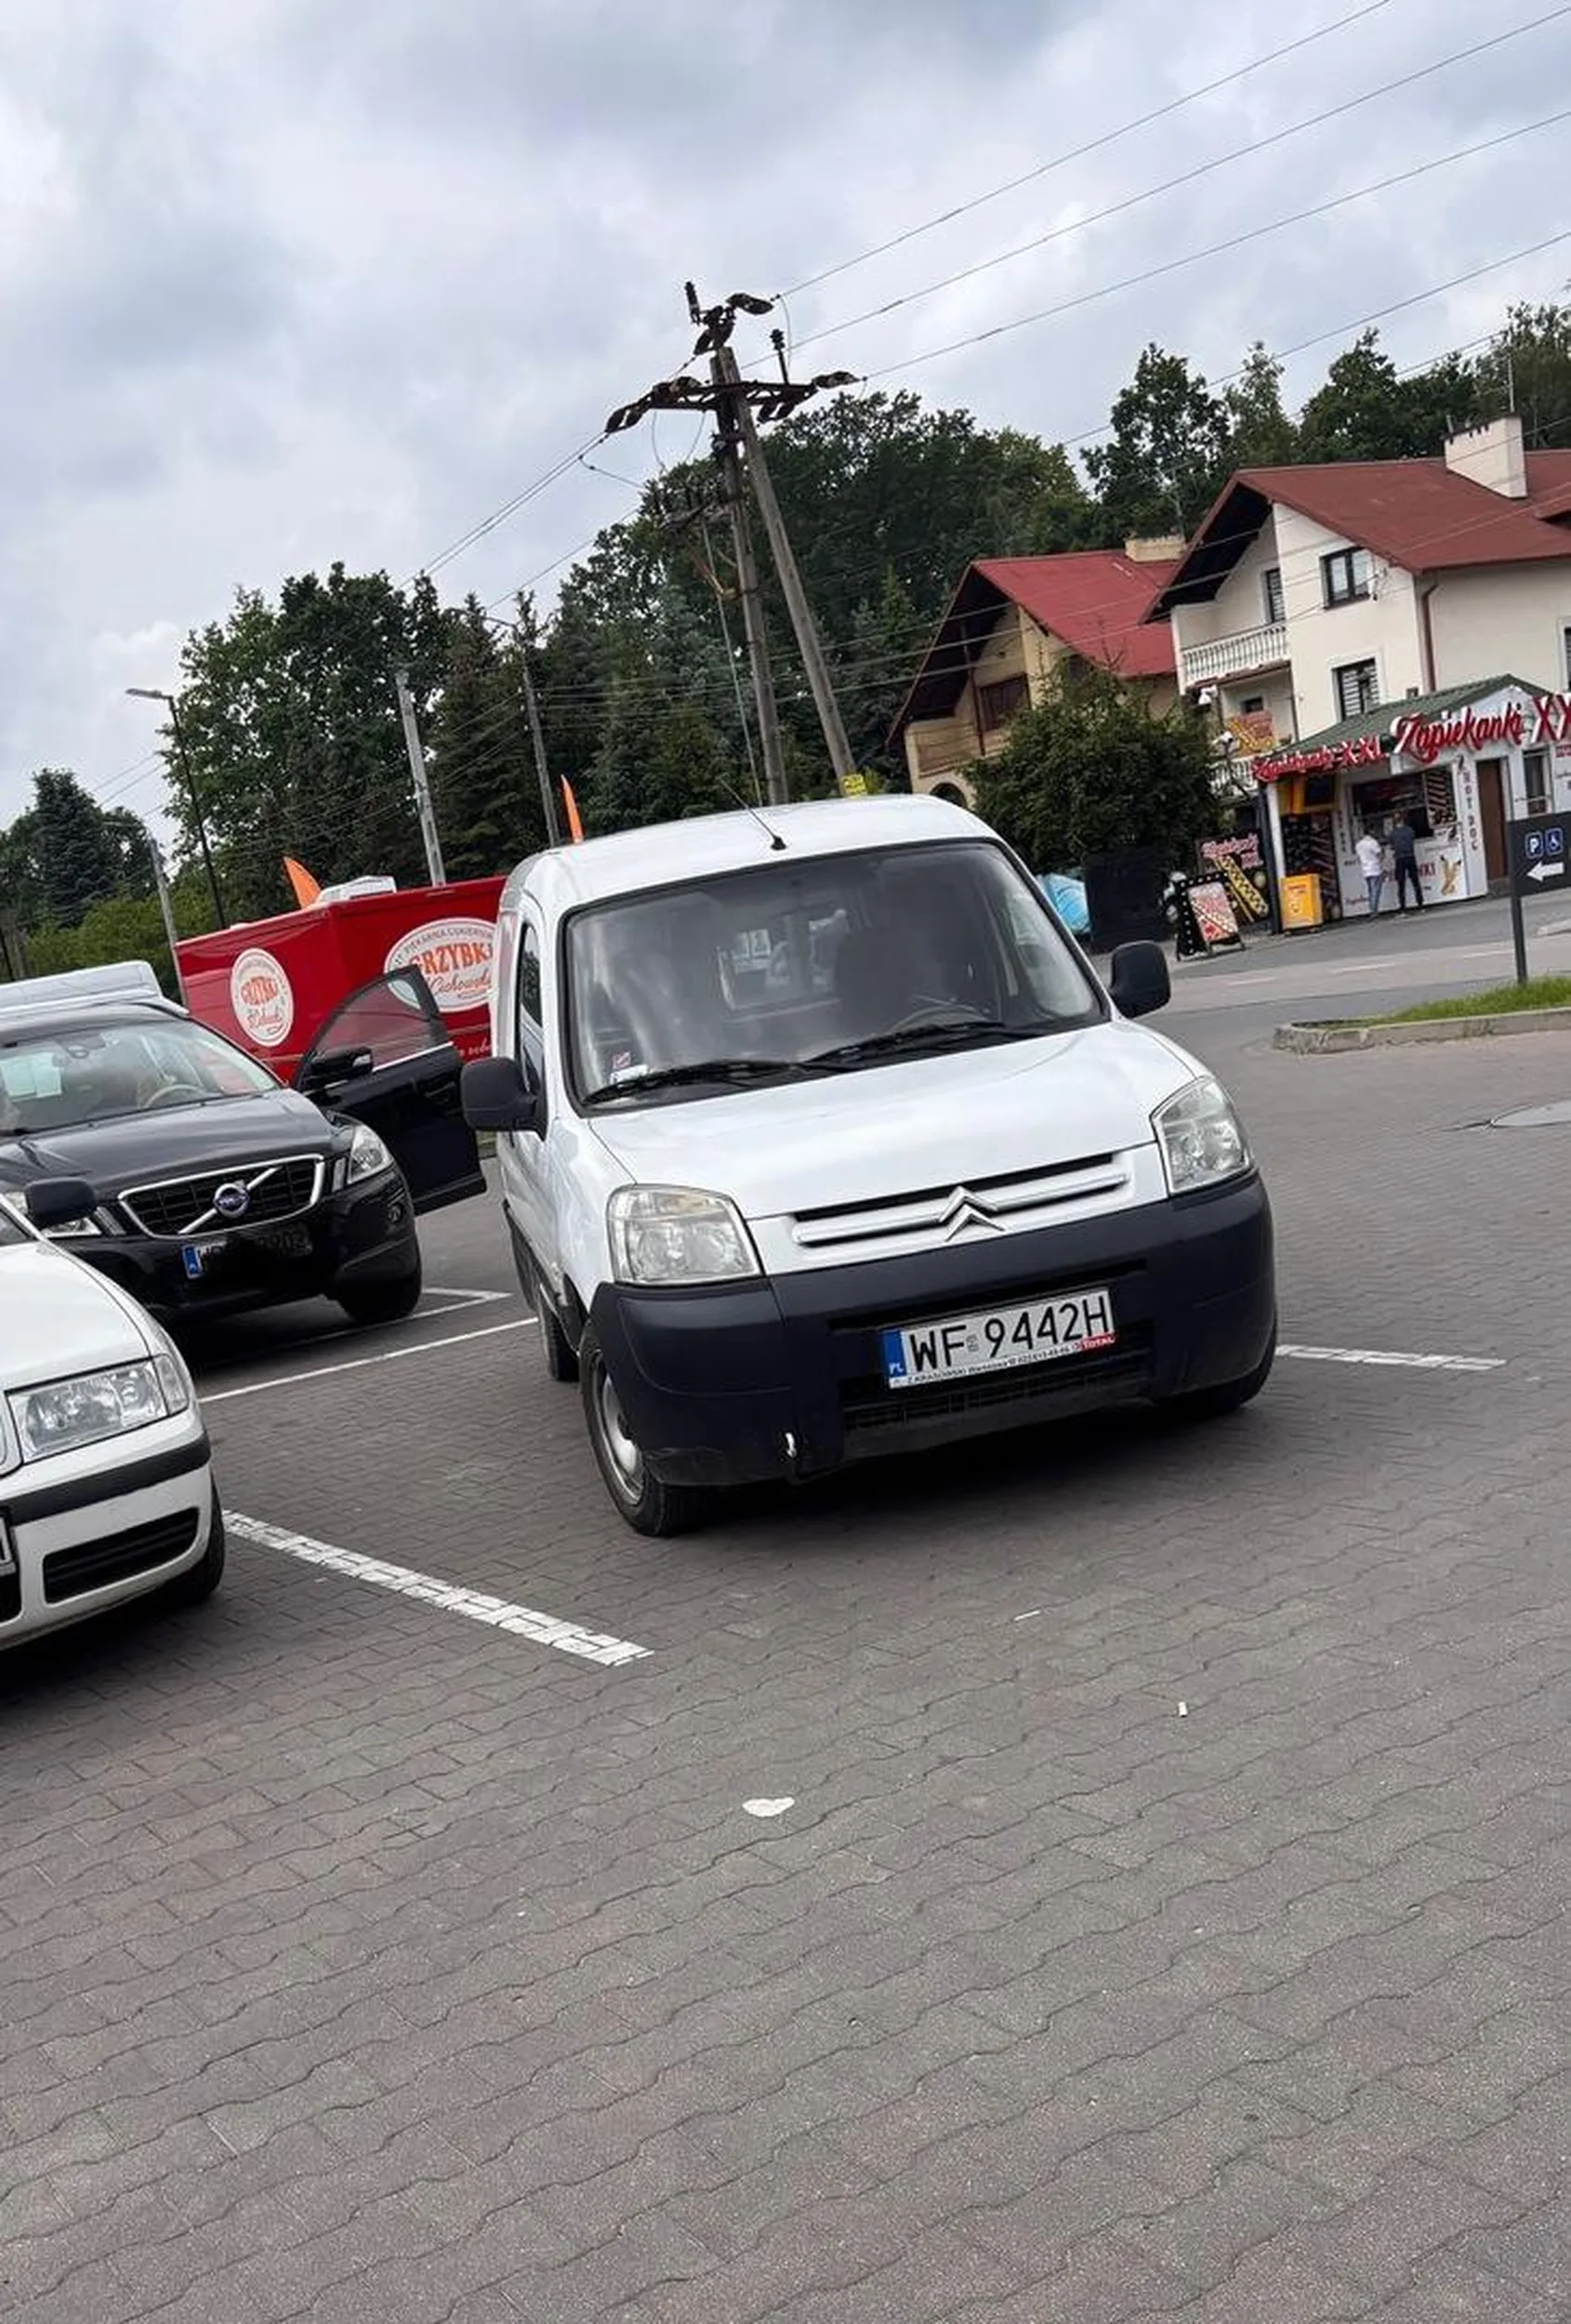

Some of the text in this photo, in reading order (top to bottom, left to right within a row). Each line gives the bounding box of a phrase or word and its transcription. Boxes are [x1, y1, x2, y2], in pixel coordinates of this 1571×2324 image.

[1390, 703, 1524, 765] Zapiekanki
[909, 1295, 1111, 1371] WF 9442H
